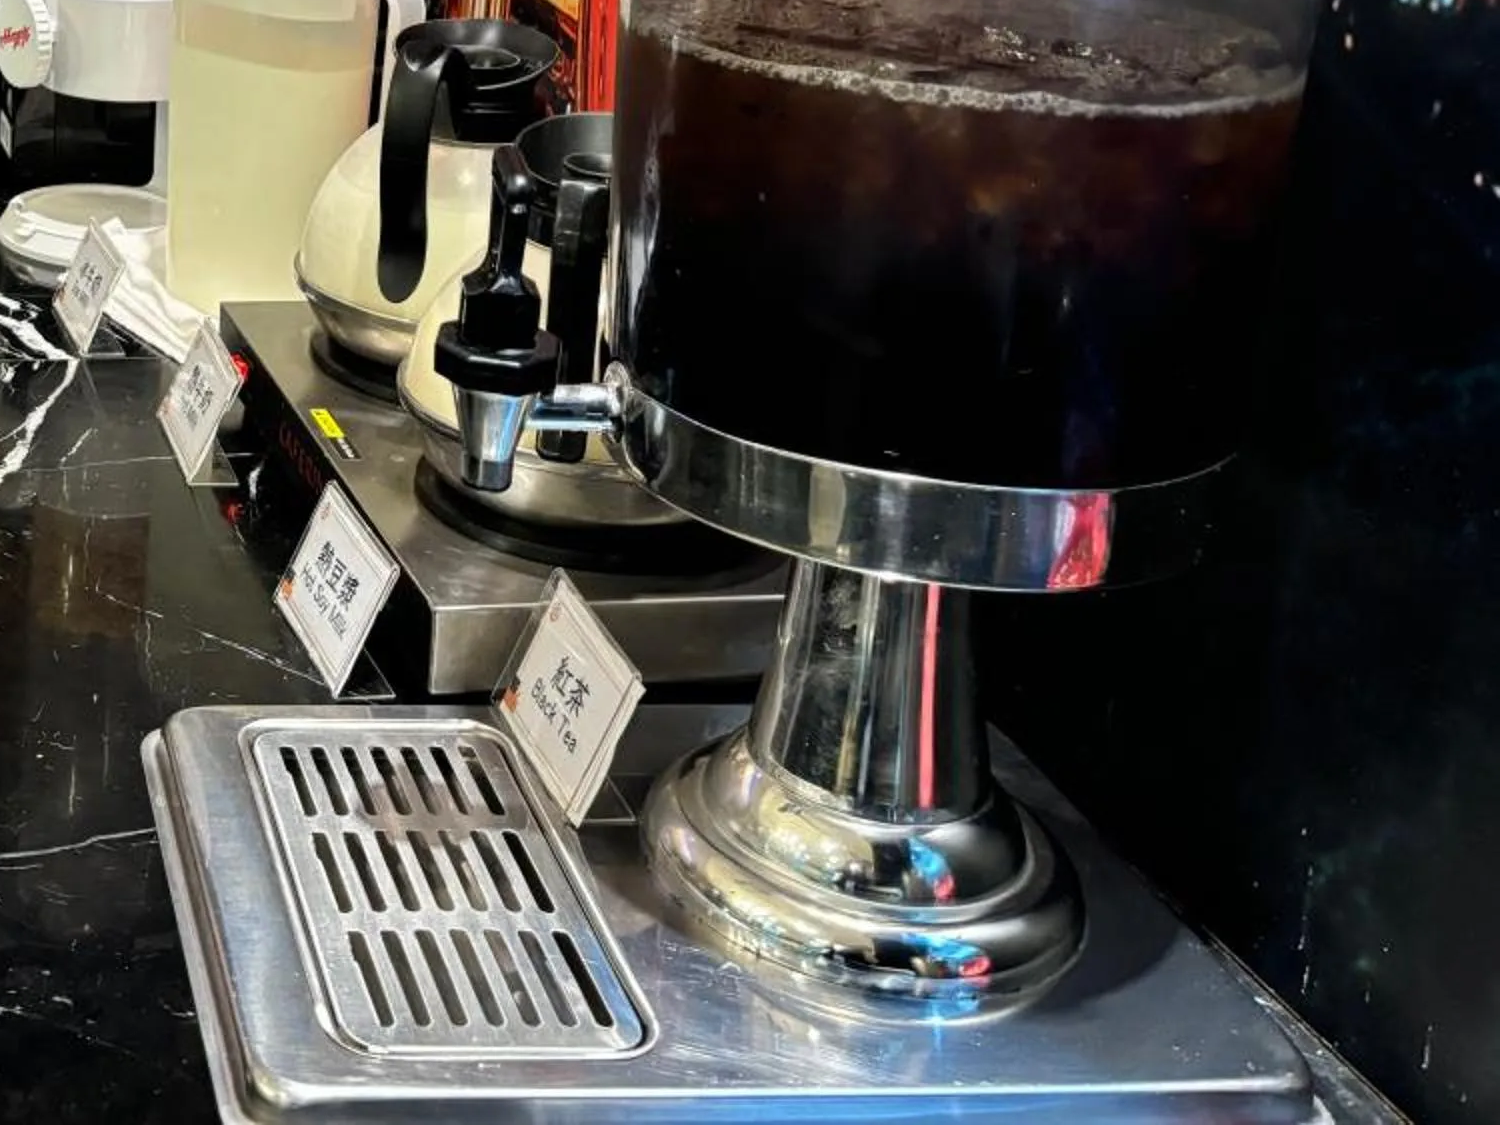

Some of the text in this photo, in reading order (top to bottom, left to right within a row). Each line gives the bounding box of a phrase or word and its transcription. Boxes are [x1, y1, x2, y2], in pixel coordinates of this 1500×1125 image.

[301, 560, 348, 642] Hot Soy Milk
[317, 540, 360, 612] 熱豆漿
[529, 676, 578, 755] Black Tea
[550, 655, 592, 718] 紅茶
